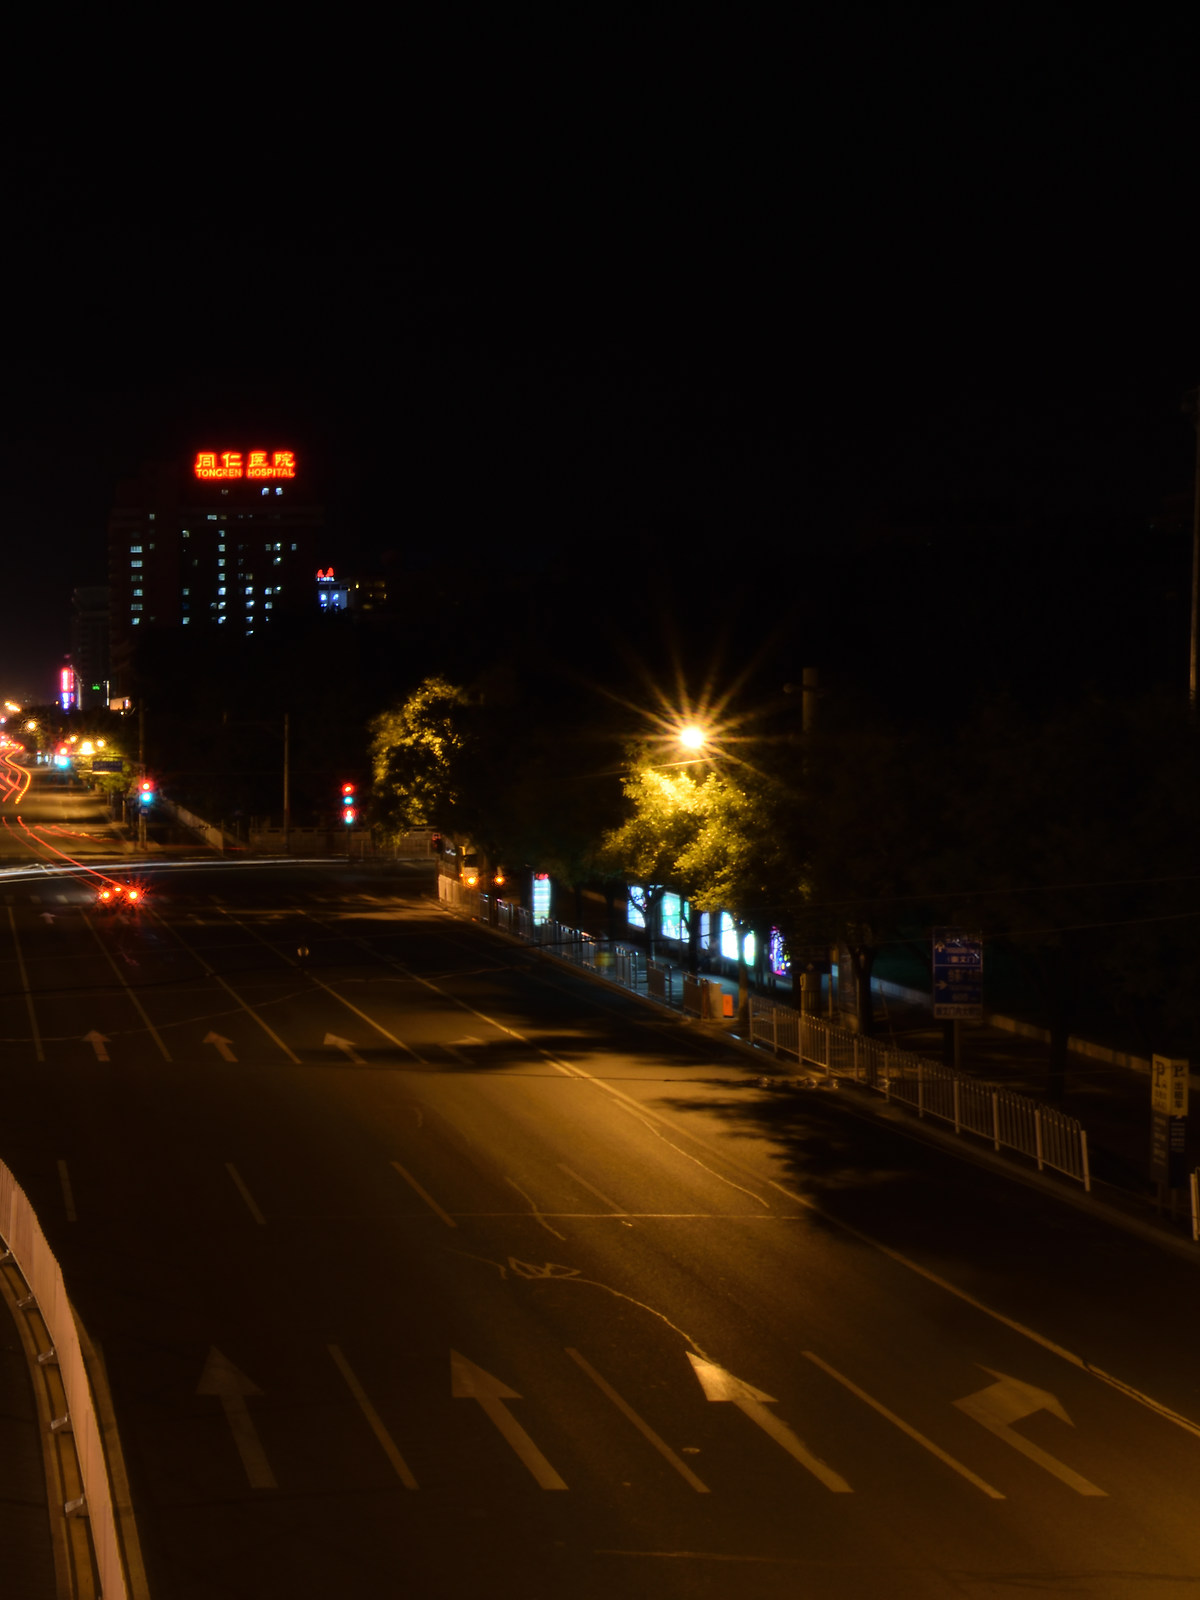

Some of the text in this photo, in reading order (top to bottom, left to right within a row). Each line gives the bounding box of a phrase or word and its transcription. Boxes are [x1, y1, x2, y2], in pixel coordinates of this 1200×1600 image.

[195, 451, 295, 468] 同仁医院
[195, 467, 295, 479] TONGREN HOSPITAL
